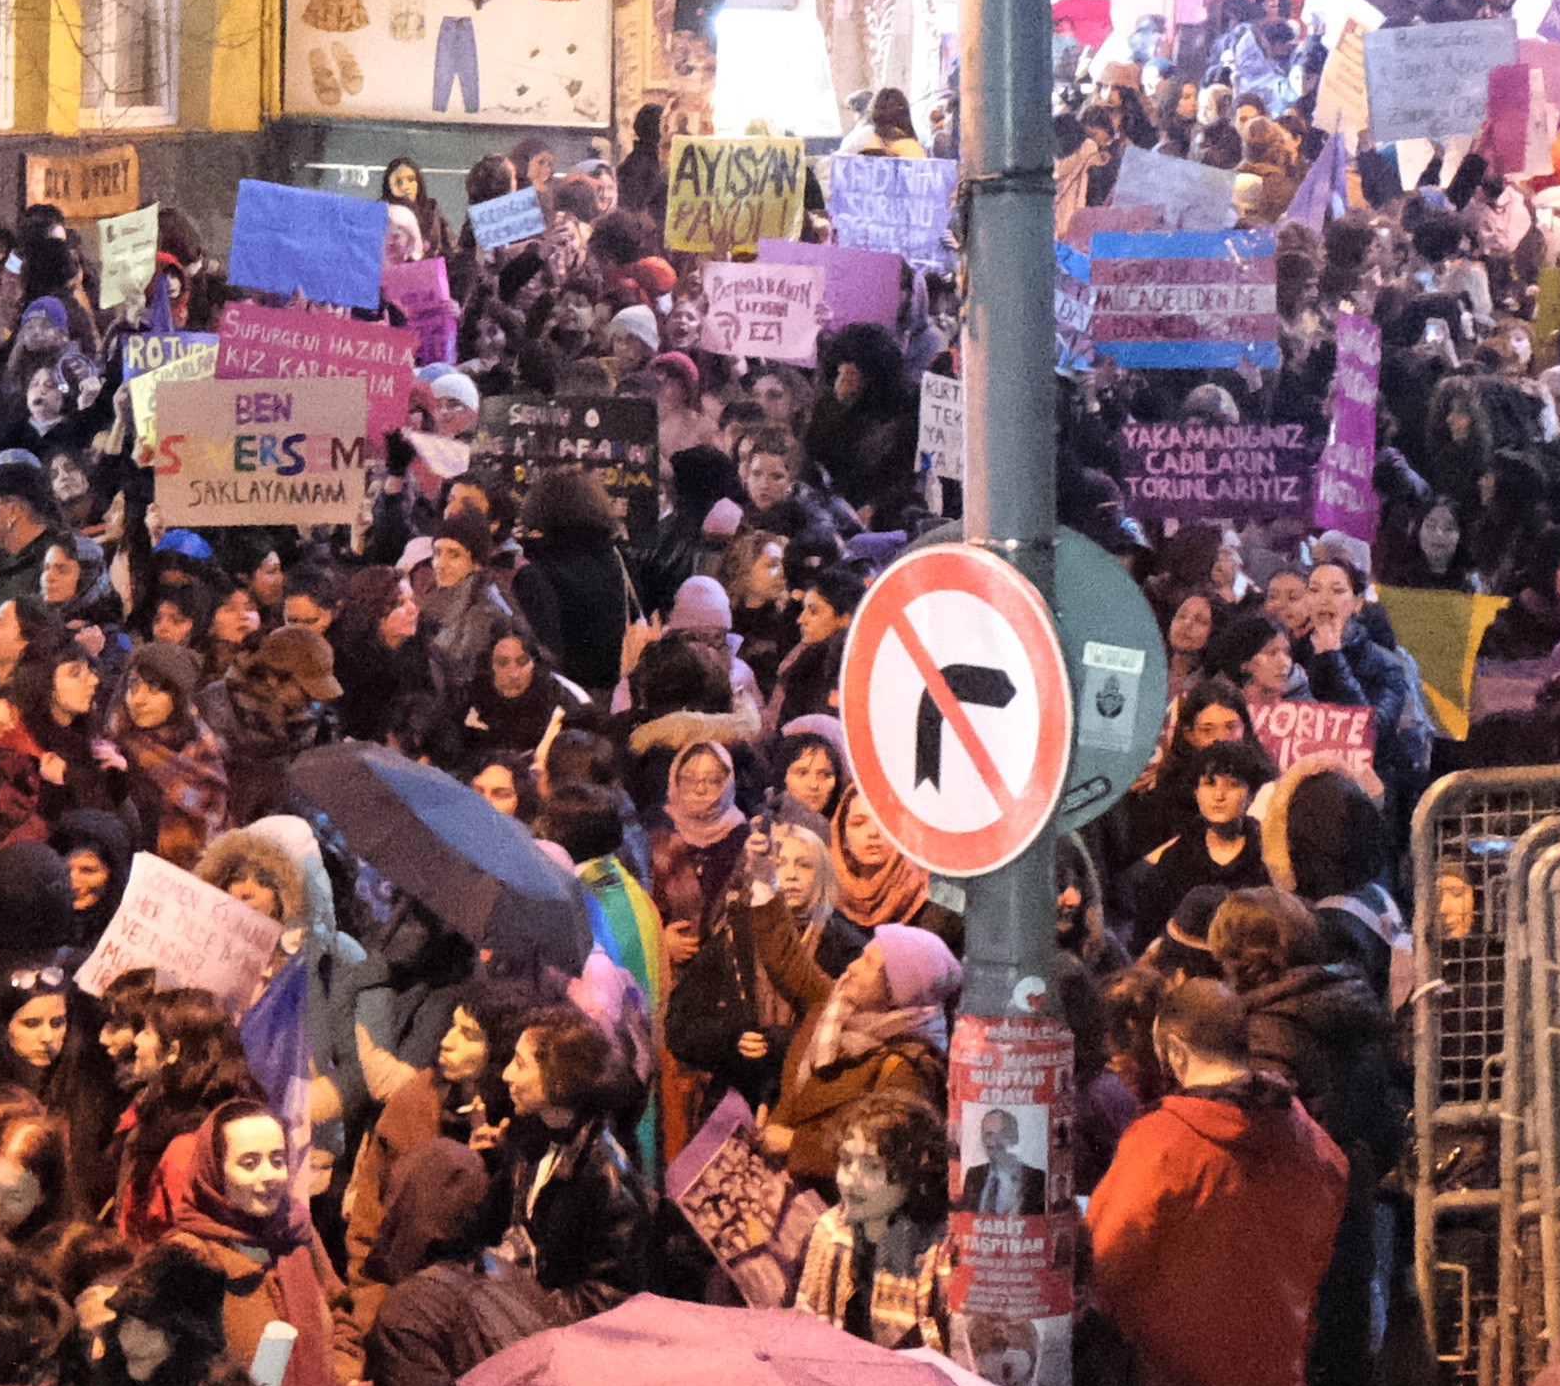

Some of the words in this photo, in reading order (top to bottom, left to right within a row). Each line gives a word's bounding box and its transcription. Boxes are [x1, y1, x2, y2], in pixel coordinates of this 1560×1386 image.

[234, 391, 294, 426] BEN
[155, 433, 365, 476] SEVERSEM
[1144, 451, 1276, 477] CADILARIN
[187, 479, 348, 509] SAKLAYAMAM
[970, 1070, 1046, 1087] MUHTAR
